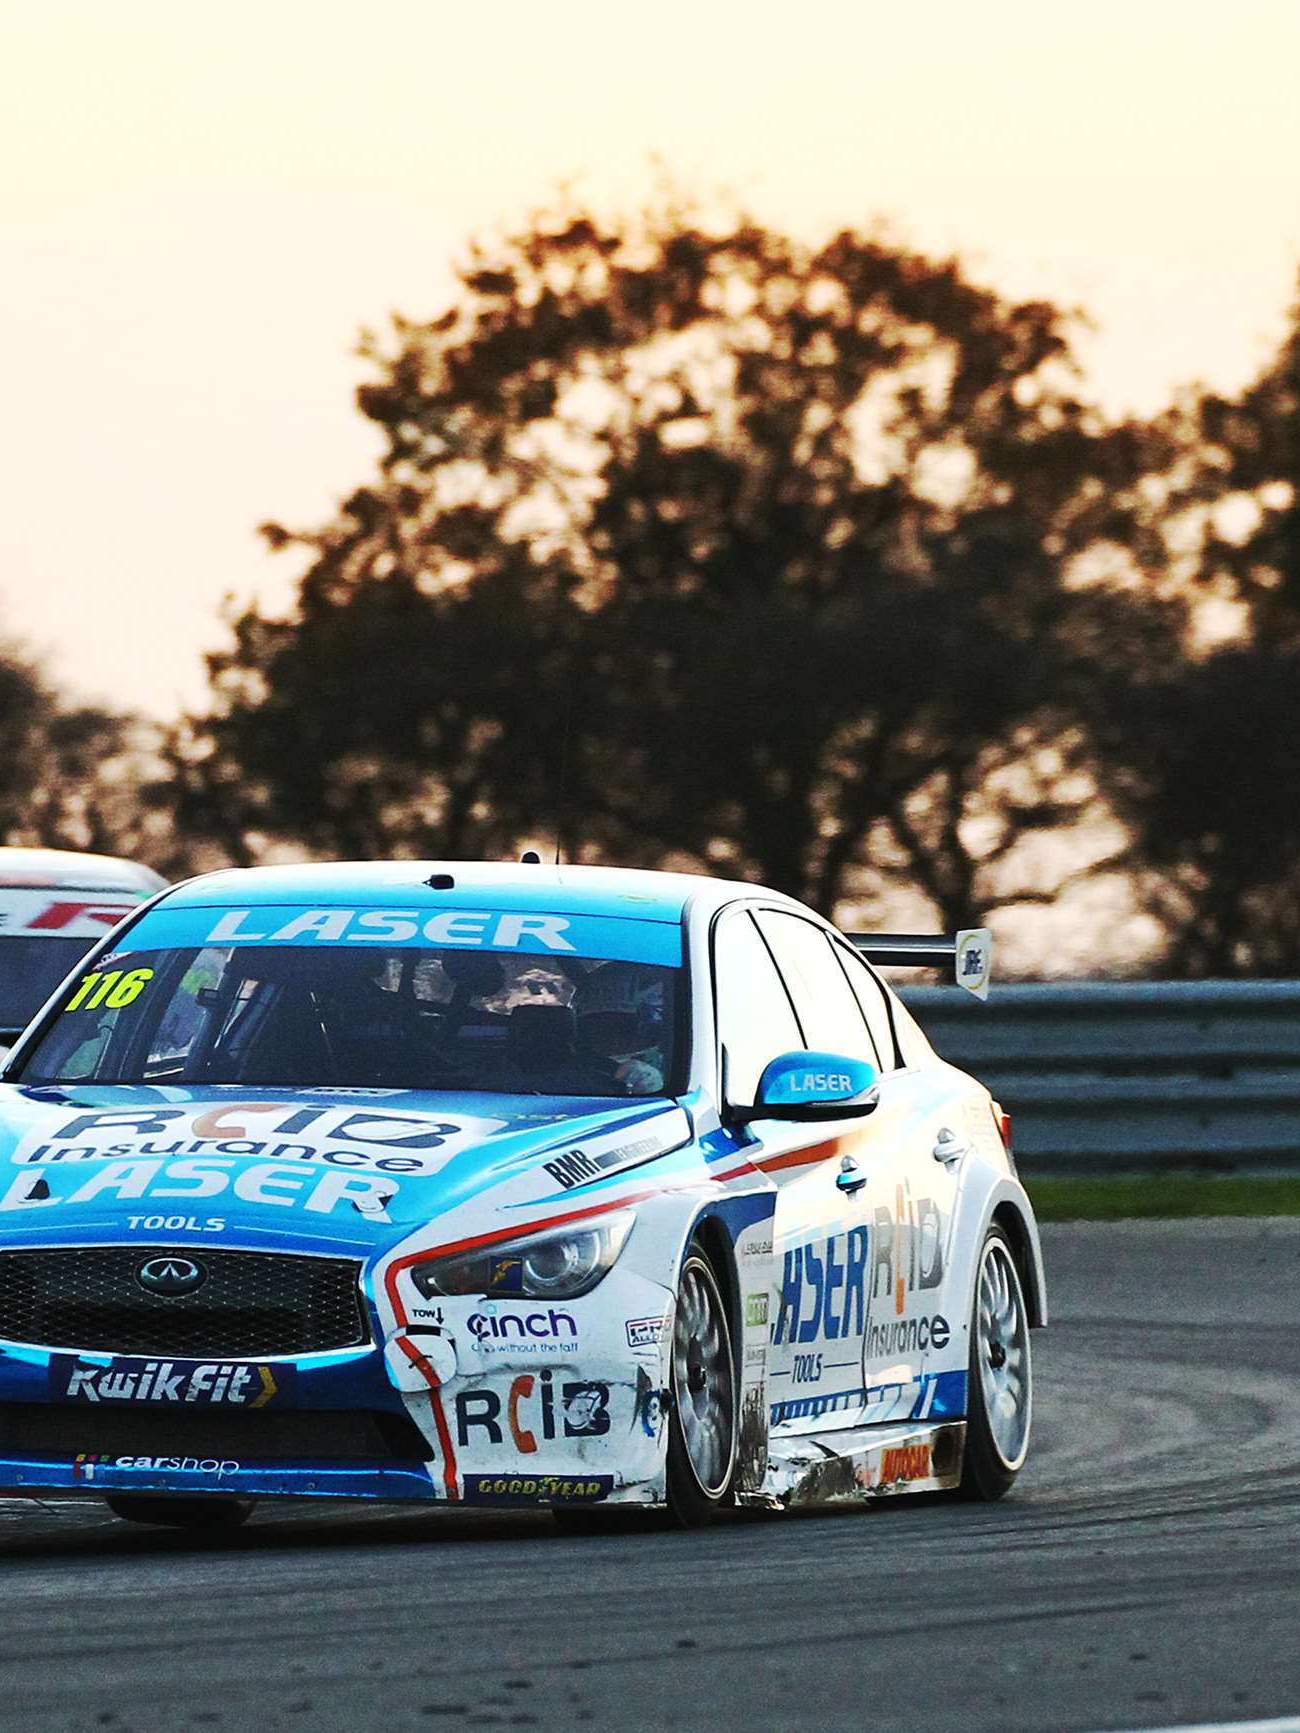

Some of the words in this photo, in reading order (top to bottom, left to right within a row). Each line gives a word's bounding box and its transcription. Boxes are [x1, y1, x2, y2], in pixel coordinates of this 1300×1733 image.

[205, 910, 577, 951] LASER
[64, 968, 154, 1012] 116
[790, 1073, 853, 1092] LASER
[28, 1140, 424, 1173] Insurance
[542, 1150, 599, 1190] BMR
[127, 1216, 226, 1233] TOOLS
[412, 1308, 435, 1319] TOW
[467, 1306, 578, 1338] cinch
[540, 1343, 557, 1353] the
[866, 1314, 950, 1359] Insurance
[792, 1354, 823, 1384] TOOLS
[115, 1454, 240, 1480] carshop
